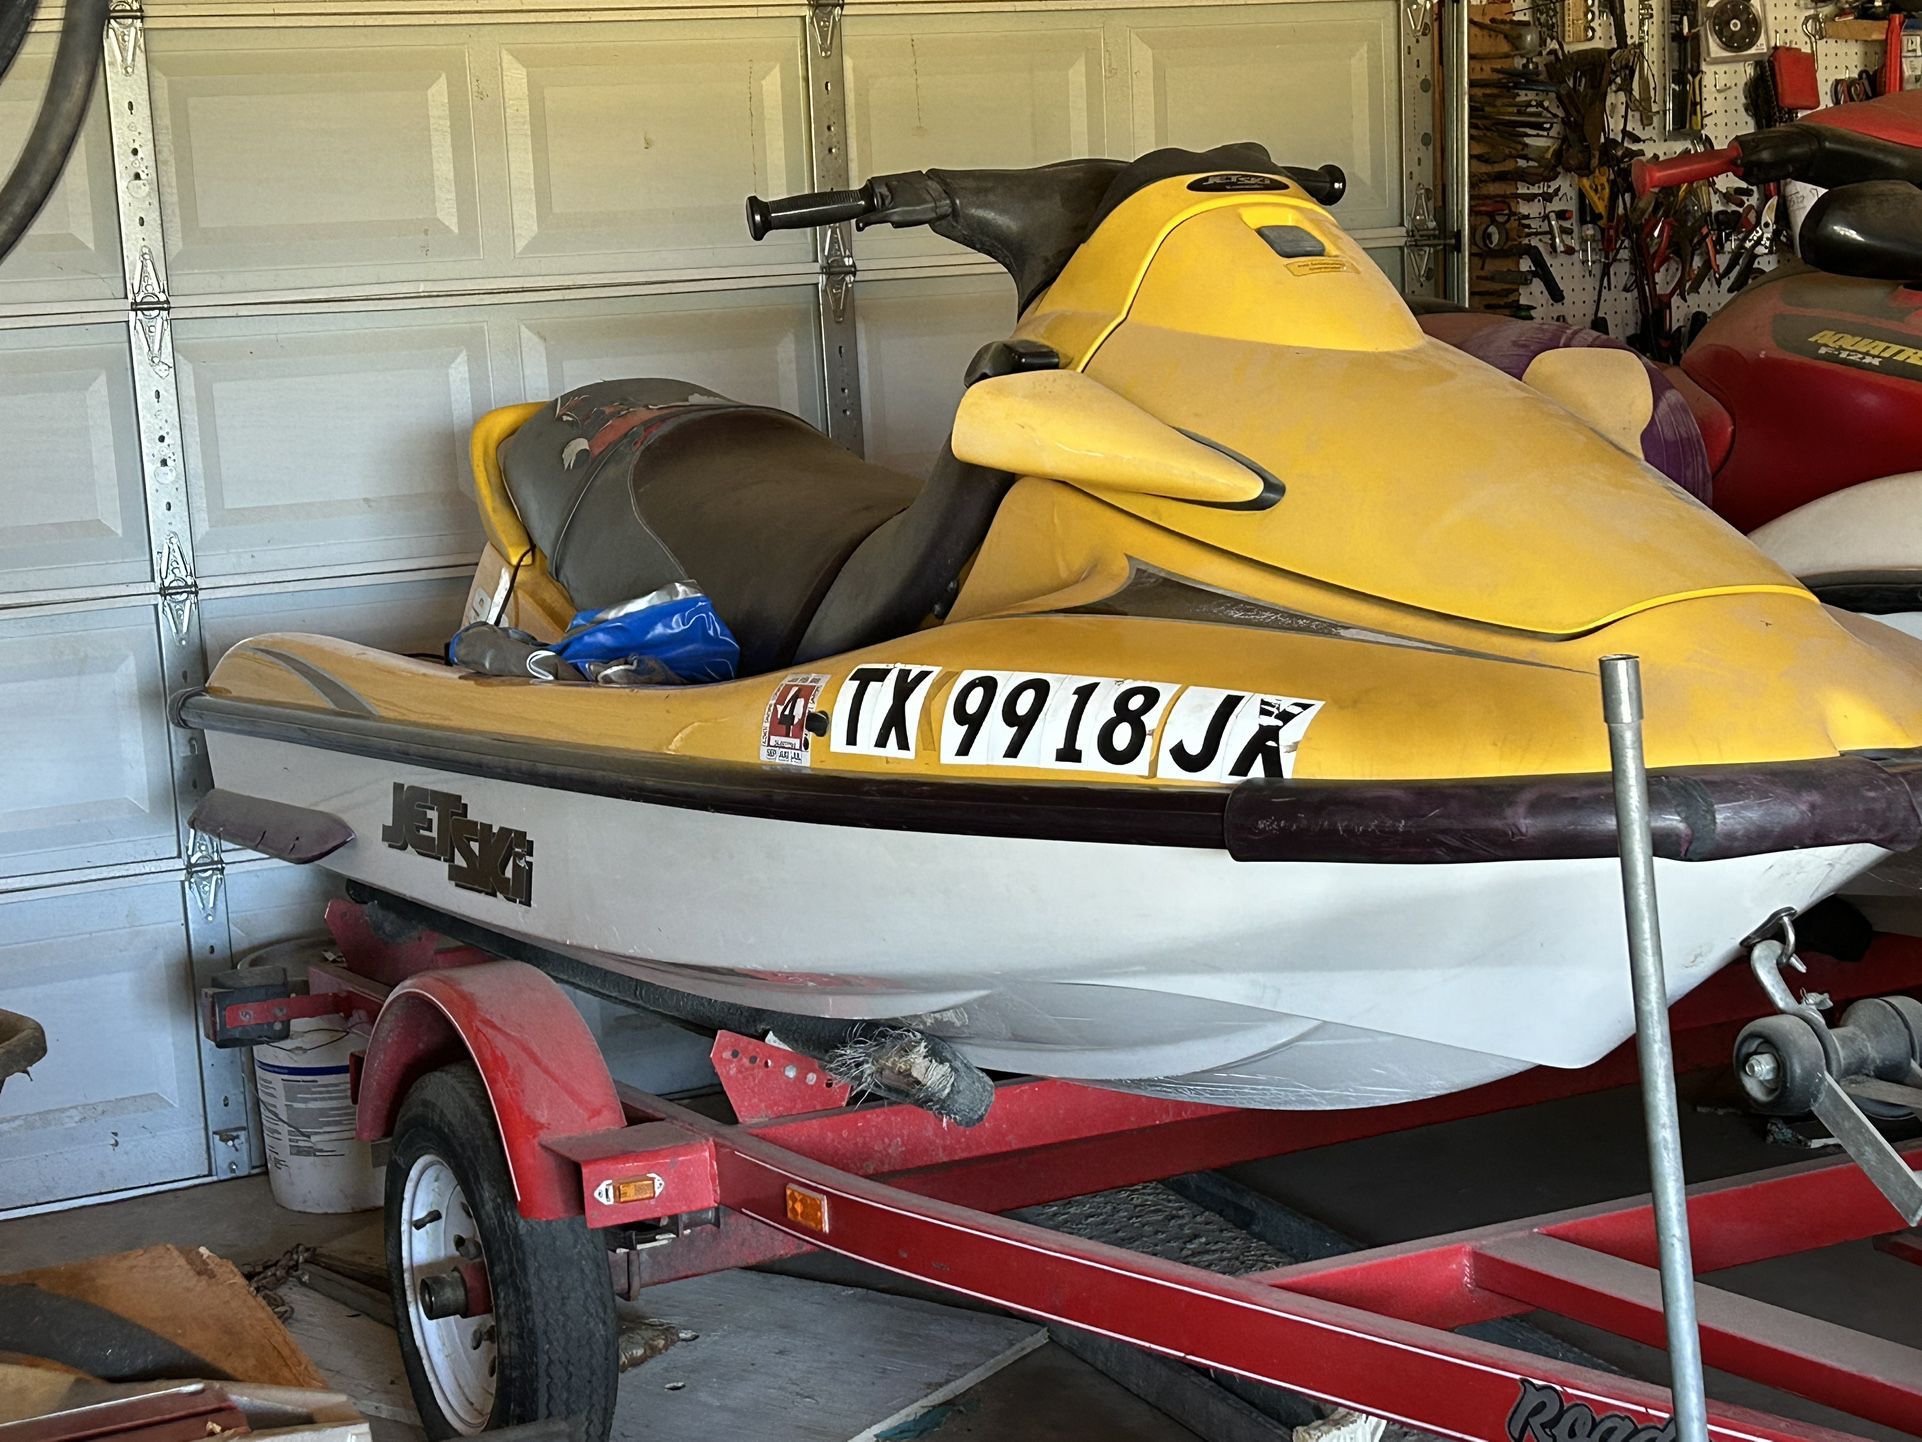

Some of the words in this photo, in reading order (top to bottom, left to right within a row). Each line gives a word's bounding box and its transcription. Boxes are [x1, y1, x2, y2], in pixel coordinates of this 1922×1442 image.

[1818, 346, 1882, 365] F-12X
[778, 686, 800, 738] 4
[848, 667, 933, 752] TX
[952, 675, 1161, 766] 9918
